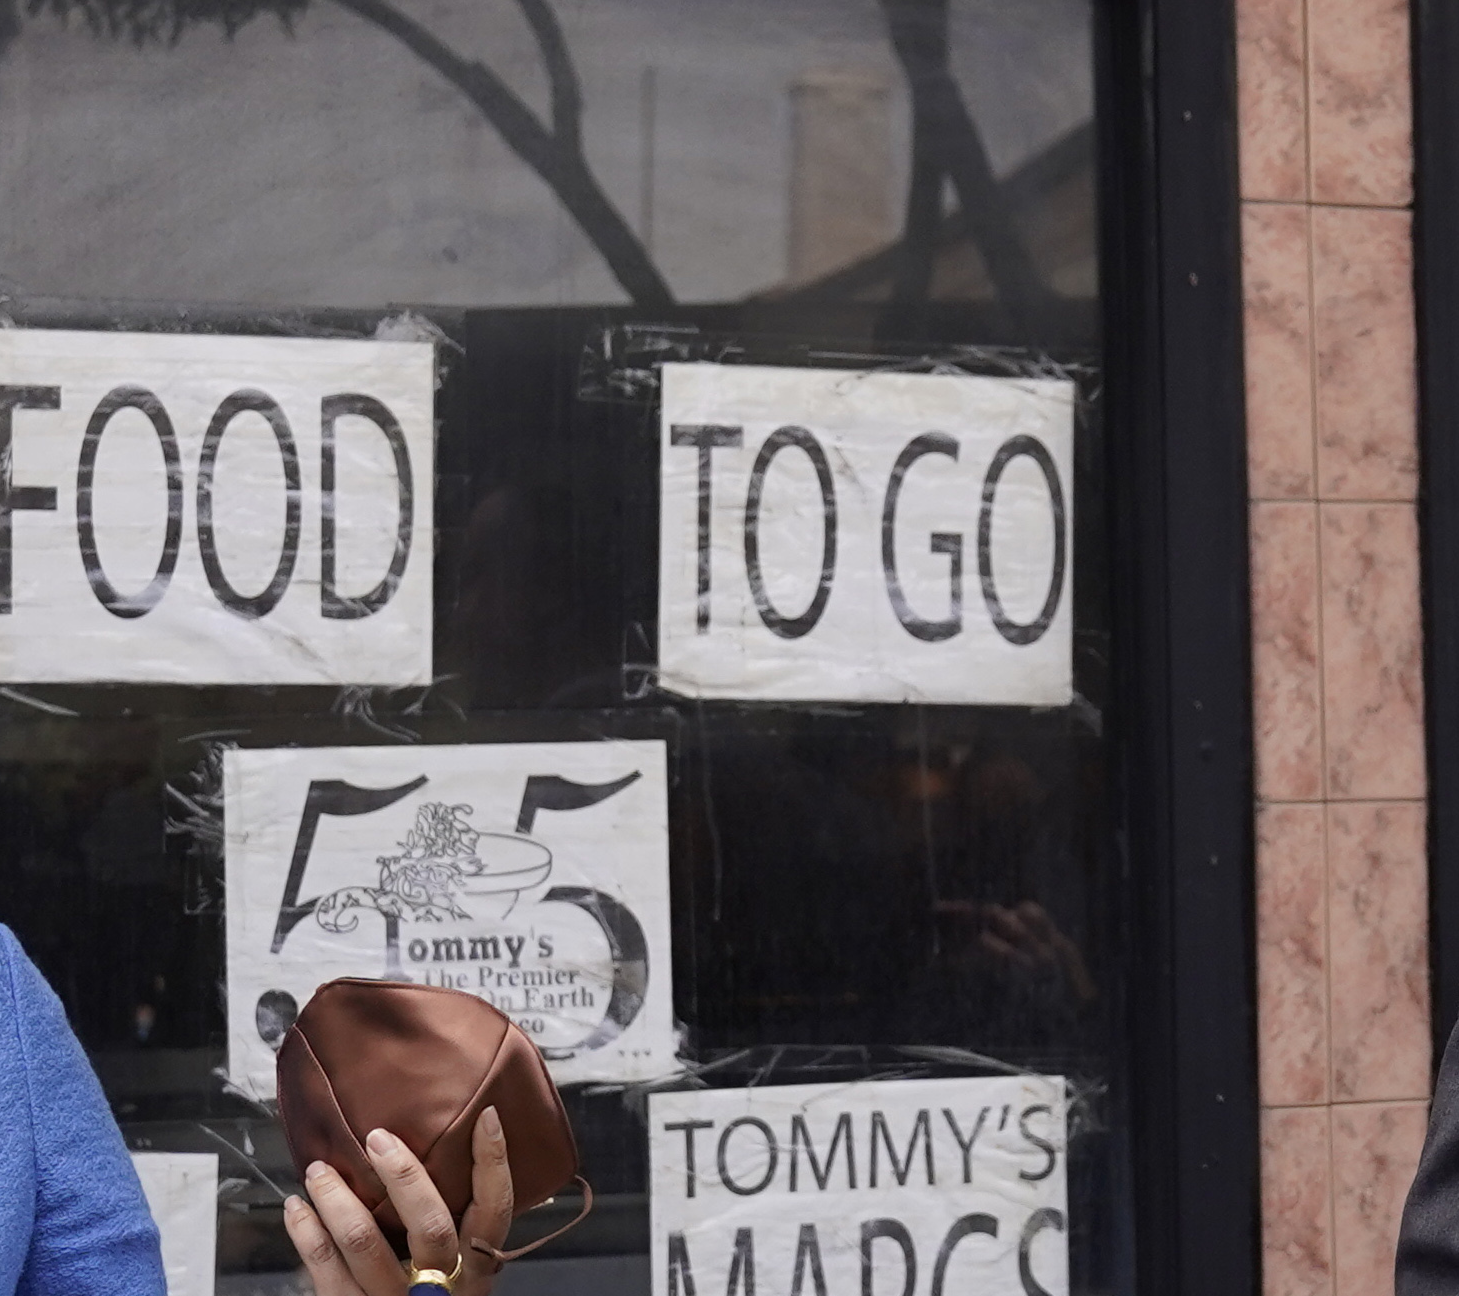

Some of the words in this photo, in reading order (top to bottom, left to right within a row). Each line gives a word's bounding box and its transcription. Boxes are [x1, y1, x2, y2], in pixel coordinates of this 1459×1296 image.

[670, 423, 838, 640] TO
[882, 430, 1067, 646] GO
[478, 967, 581, 987] Premier
[523, 986, 595, 1009] Earth
[664, 1104, 1057, 1199] TOMMY'S
